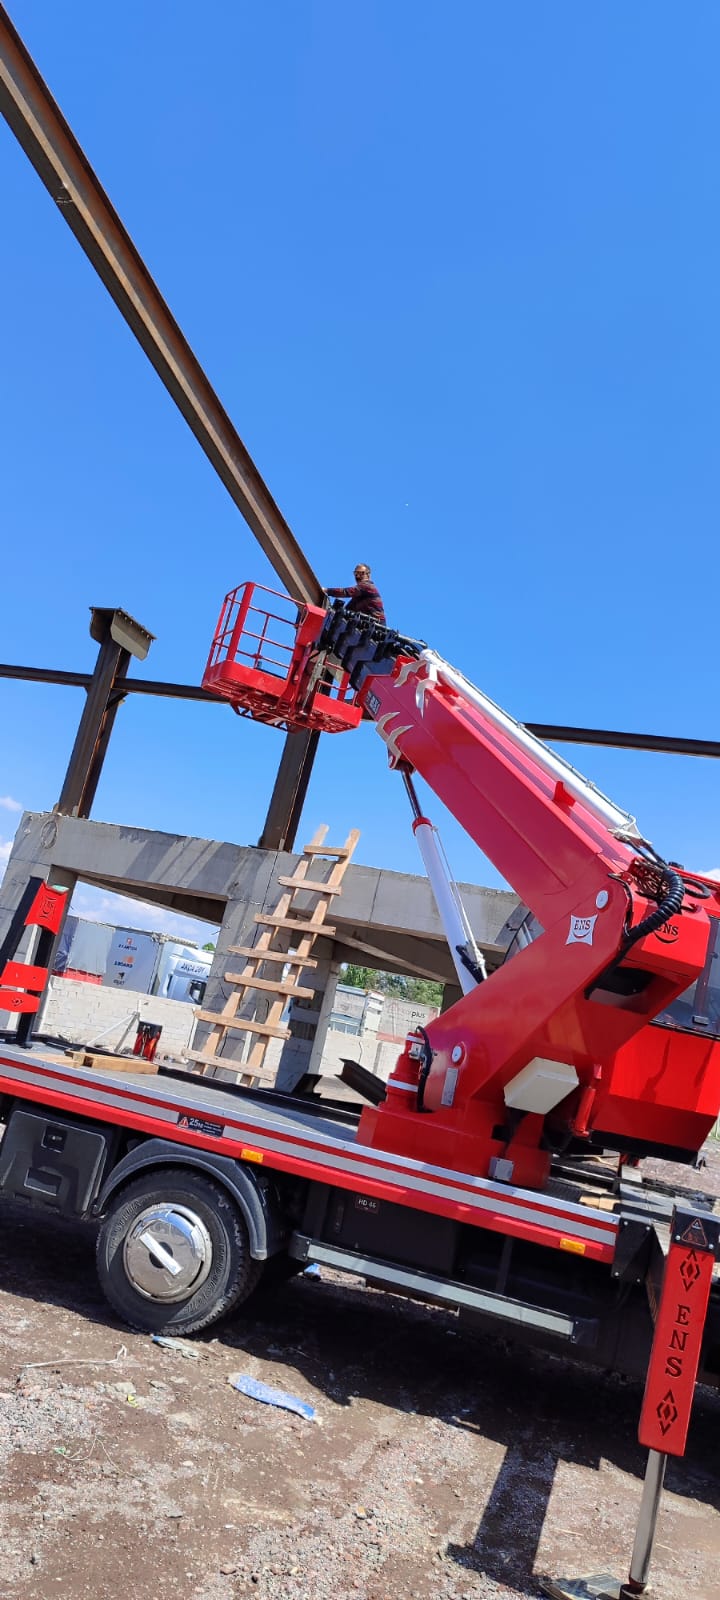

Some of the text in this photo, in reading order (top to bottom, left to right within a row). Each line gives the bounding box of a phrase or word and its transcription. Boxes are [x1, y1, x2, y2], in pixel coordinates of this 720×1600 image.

[573, 919, 591, 931] ENS
[657, 923, 679, 937] NS
[664, 1303, 692, 1379] ENS
